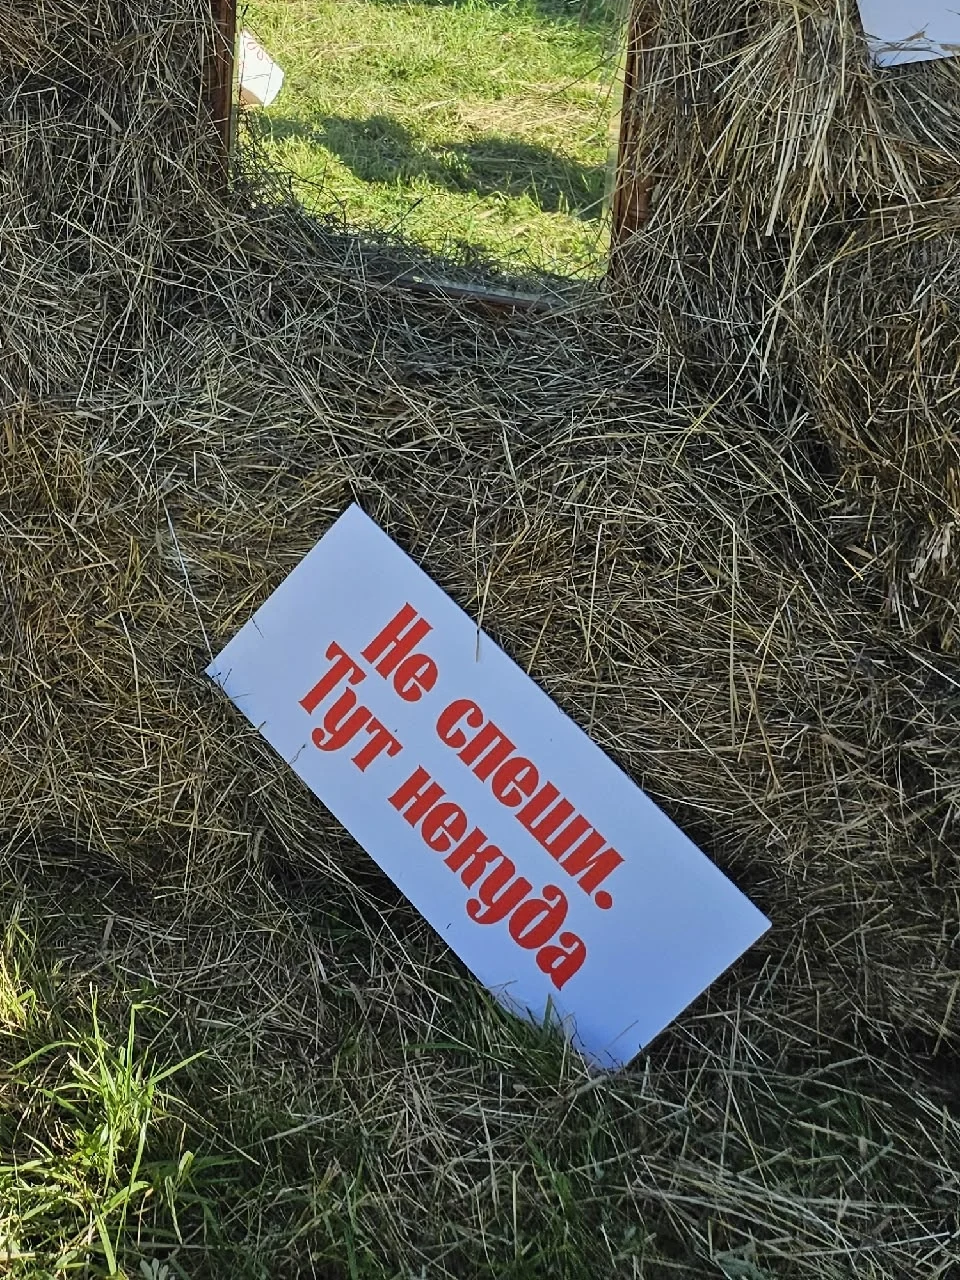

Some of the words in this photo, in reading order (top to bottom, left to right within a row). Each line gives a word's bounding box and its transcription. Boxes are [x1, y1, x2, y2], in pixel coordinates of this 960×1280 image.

[298, 640, 404, 773] Тут
[386, 765, 588, 991] некуда
[360, 602, 439, 703] Не
[435, 698, 626, 911] спеши.
